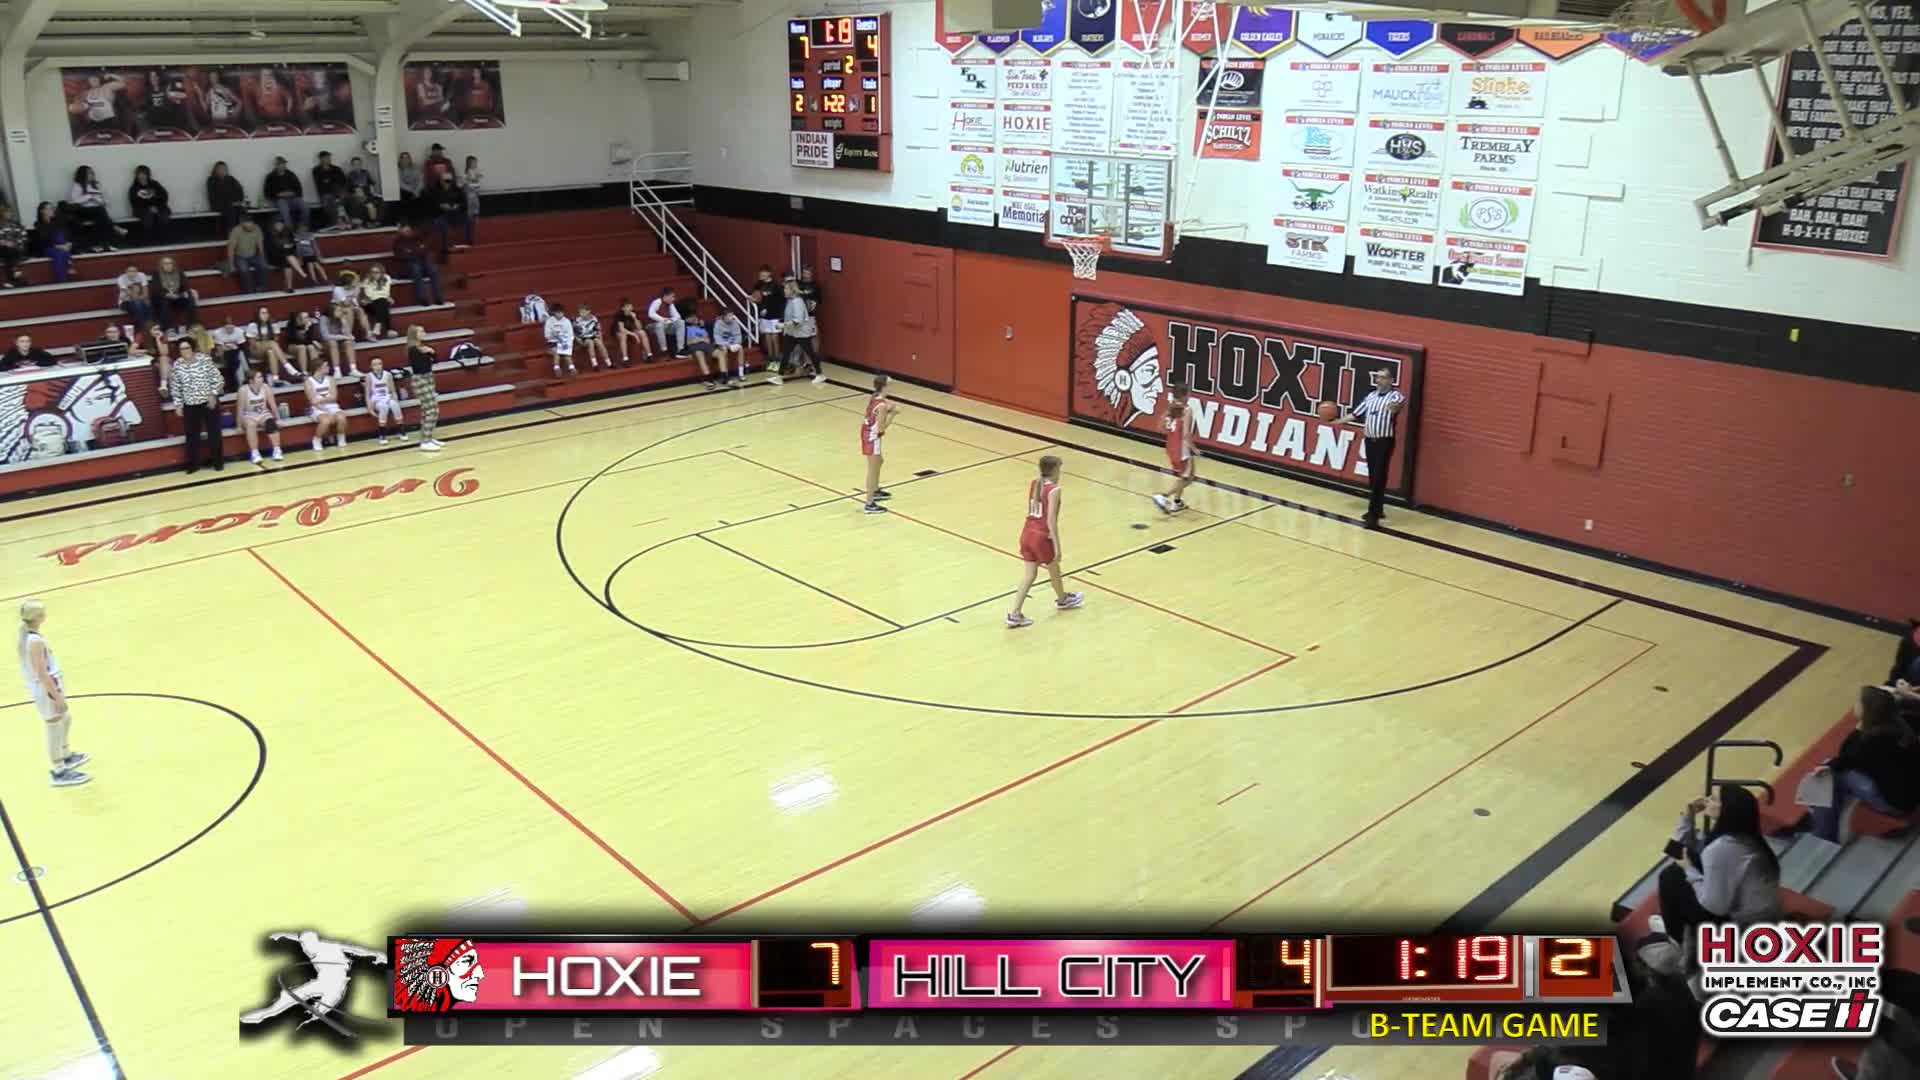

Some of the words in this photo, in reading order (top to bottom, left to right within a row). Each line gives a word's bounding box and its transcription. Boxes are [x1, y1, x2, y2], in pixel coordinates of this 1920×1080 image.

[1003, 116, 1052, 131] HOXIE
[796, 133, 828, 145] INDIAN
[1206, 124, 1252, 146] SCHILTZ
[796, 145, 829, 159] PRIDE
[1460, 136, 1535, 153] TREMBLAY
[1473, 152, 1516, 165] FARMS
[1005, 159, 1049, 175] Nutrien
[1003, 204, 1045, 224] Memoria
[1366, 243, 1425, 262] WOOFTER
[1167, 391, 1370, 477] NDIAN
